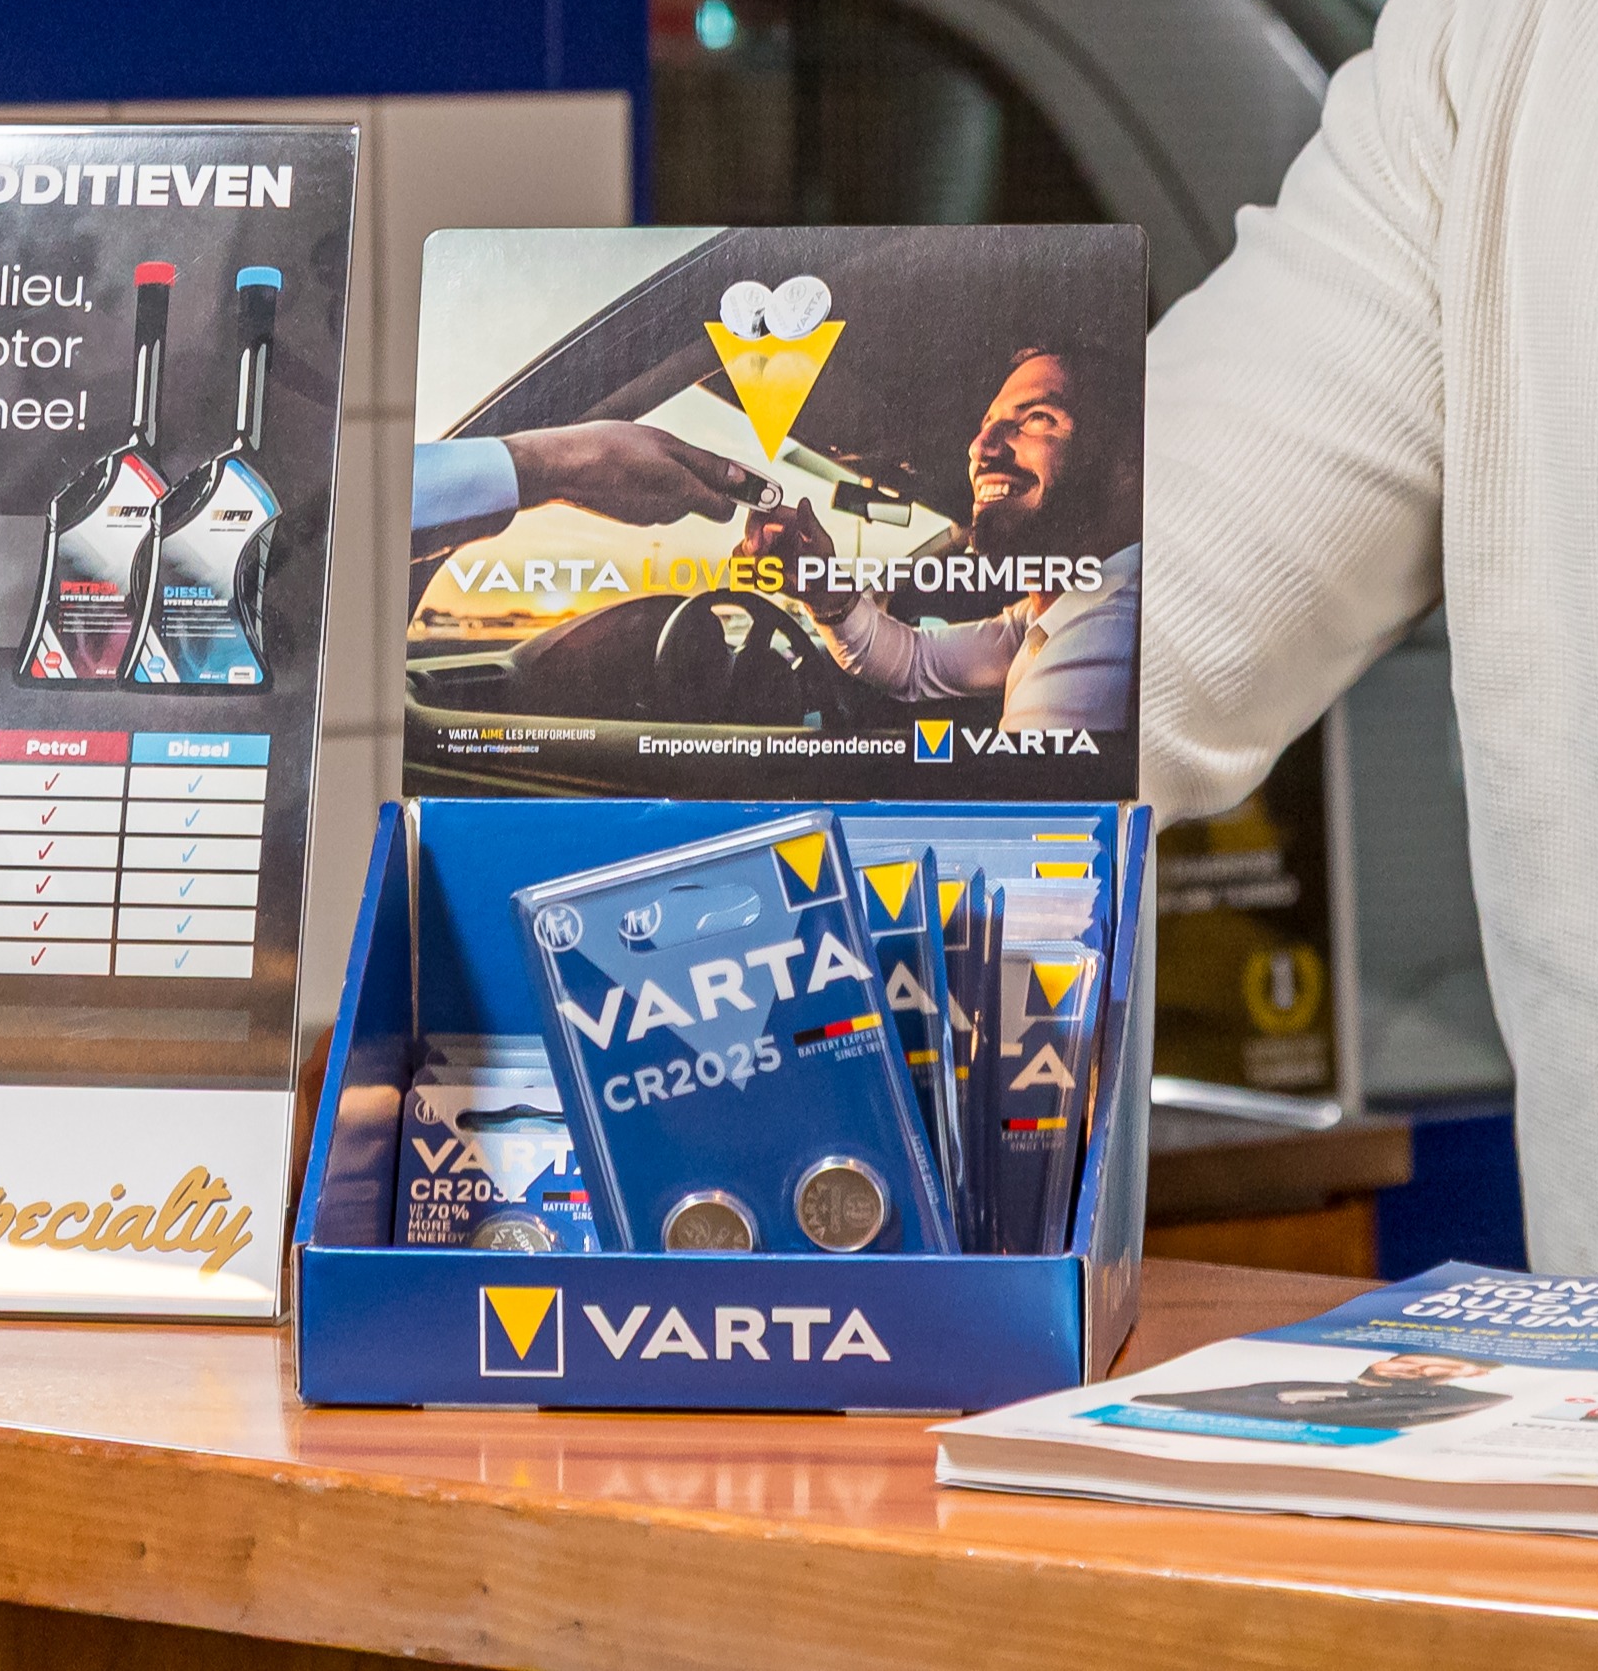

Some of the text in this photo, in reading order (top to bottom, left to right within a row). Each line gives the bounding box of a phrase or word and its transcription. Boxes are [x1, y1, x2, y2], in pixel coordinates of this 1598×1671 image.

[445, 556, 1103, 593] VARTA LOVES PERFORMERS
[163, 586, 215, 599] DIESEL
[449, 729, 596, 741] VARTA AIME LES PERFORMEURS
[961, 728, 1100, 755] VARTA
[26, 739, 88, 757] Petrol
[167, 740, 229, 758] Diesel
[638, 736, 906, 757] Empowering Independence
[557, 931, 874, 1050] VARTA
[603, 1034, 782, 1113] CR2025
[411, 1137, 581, 1175] VART
[427, 1203, 469, 1219] 70%
[572, 1211, 593, 1222] SINC
[1420, 1293, 1571, 1315] AUTO
[583, 1305, 891, 1363] VARTA
